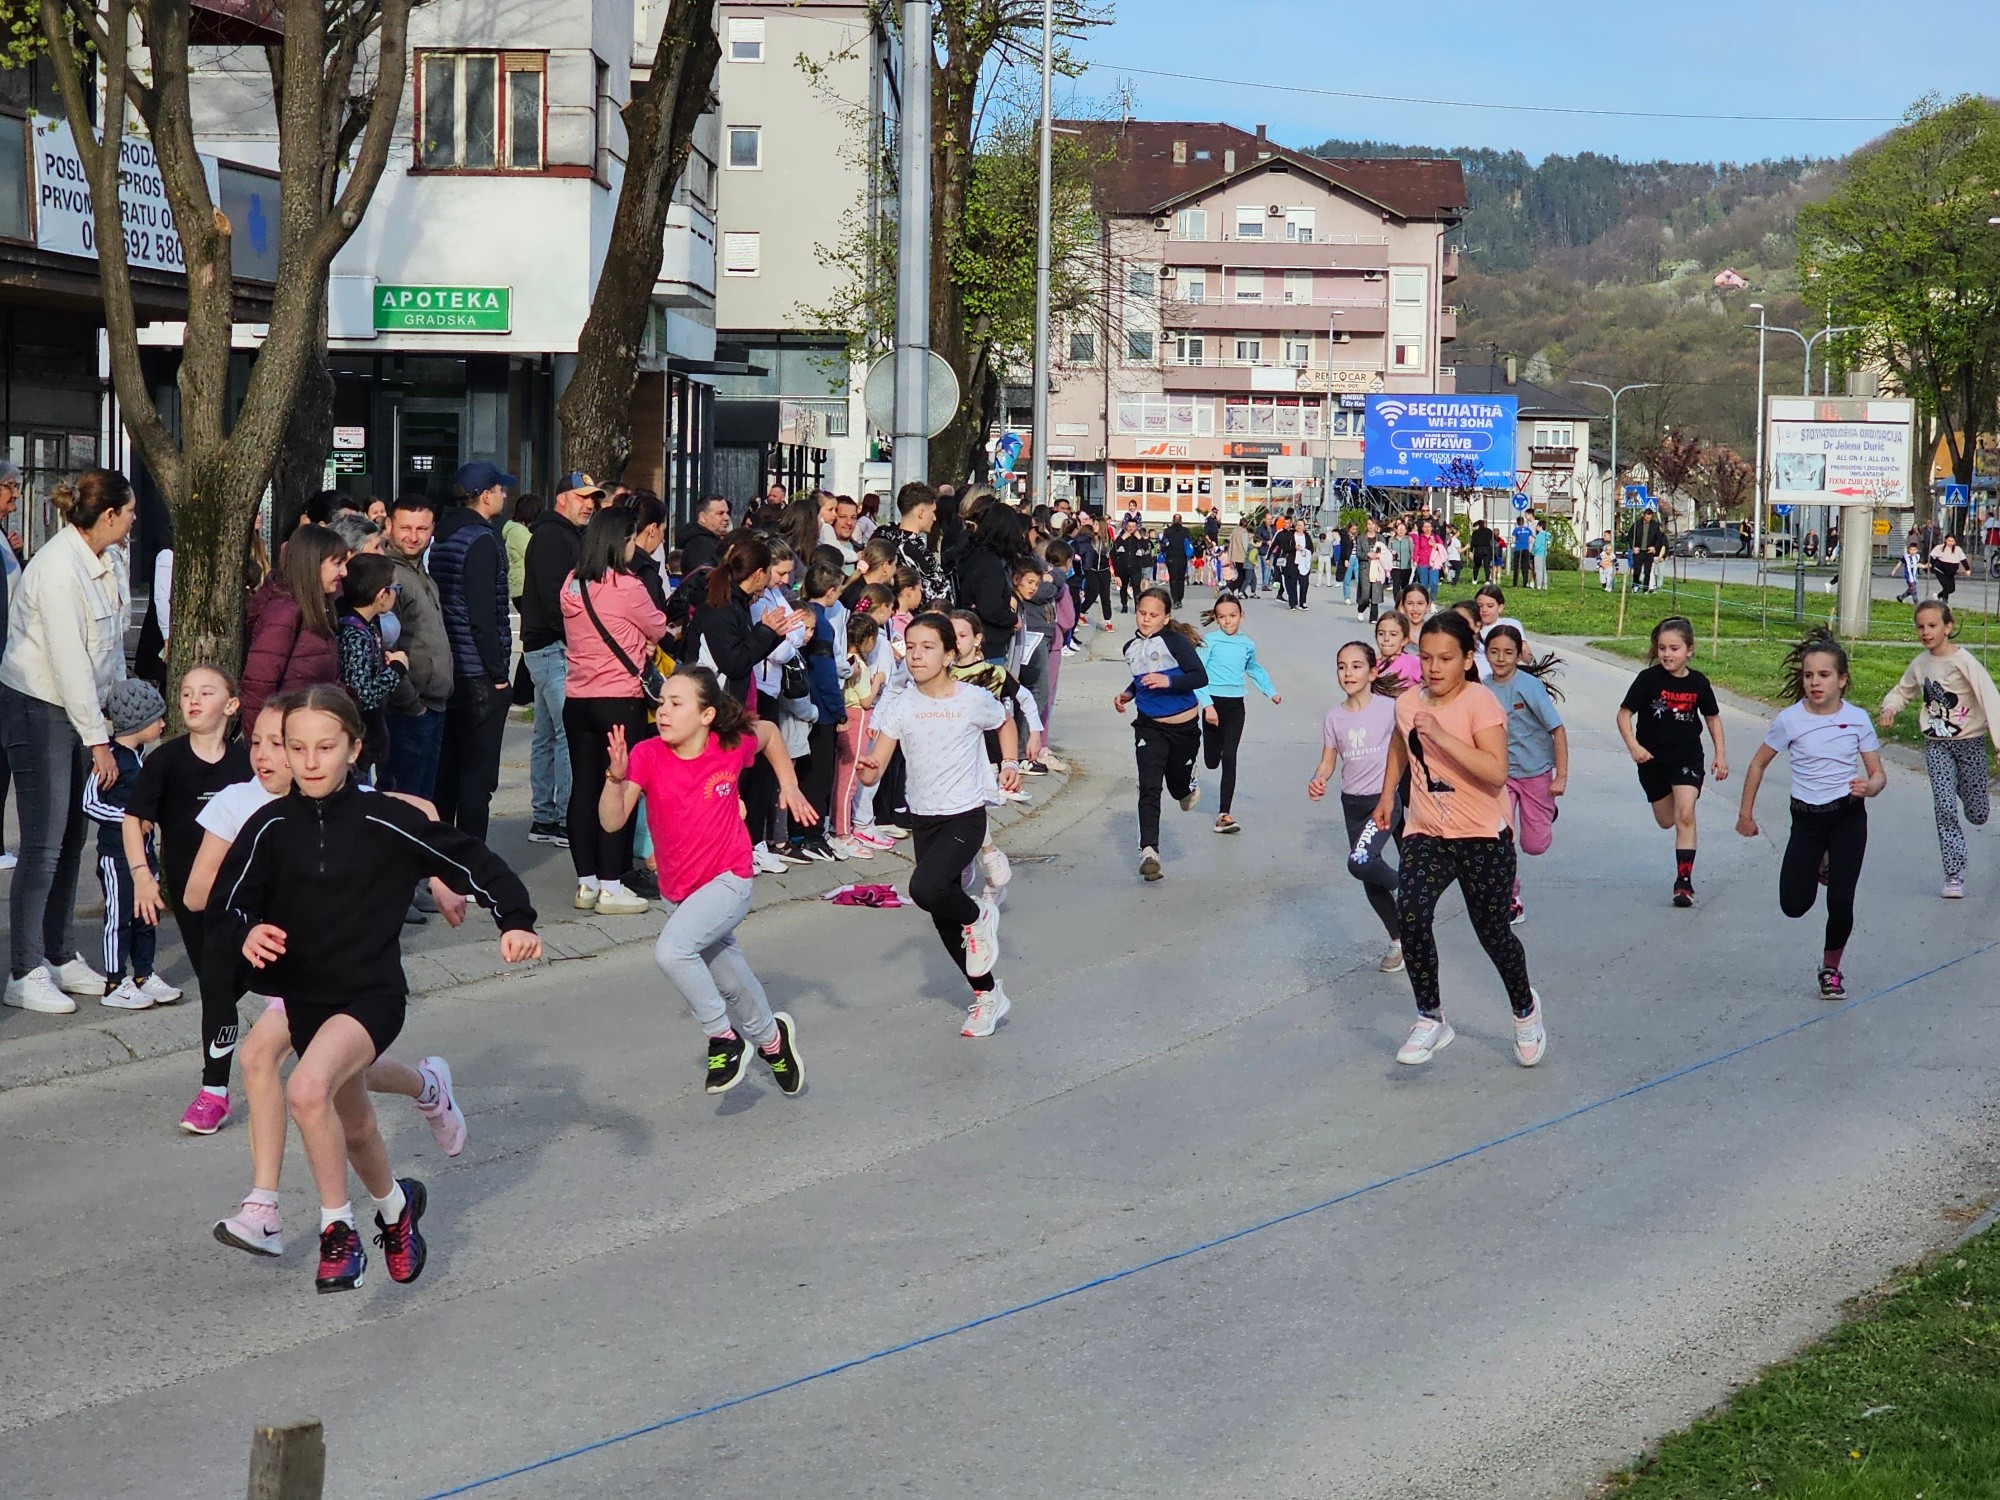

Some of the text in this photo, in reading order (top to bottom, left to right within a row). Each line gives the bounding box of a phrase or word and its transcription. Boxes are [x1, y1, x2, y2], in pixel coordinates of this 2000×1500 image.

[382, 291, 499, 308] APOTEKA
[404, 314, 477, 326] GRADSKA
[1348, 372, 1367, 381] CAR
[1408, 402, 1503, 418] БЕСПЛАТНА
[1428, 417, 1494, 428] WI-FI ЗОНА
[1859, 428, 1903, 443] ORDINACIJA
[1411, 437, 1472, 449] WIFI4WB
[1823, 440, 1833, 450] Dr
[1835, 441, 1861, 450] Jelena
[1168, 445, 1187, 456] EKI
[1828, 477, 1845, 485] FIXNI
[912, 710, 963, 720] ADORABLE
[216, 1025, 238, 1044] NI
